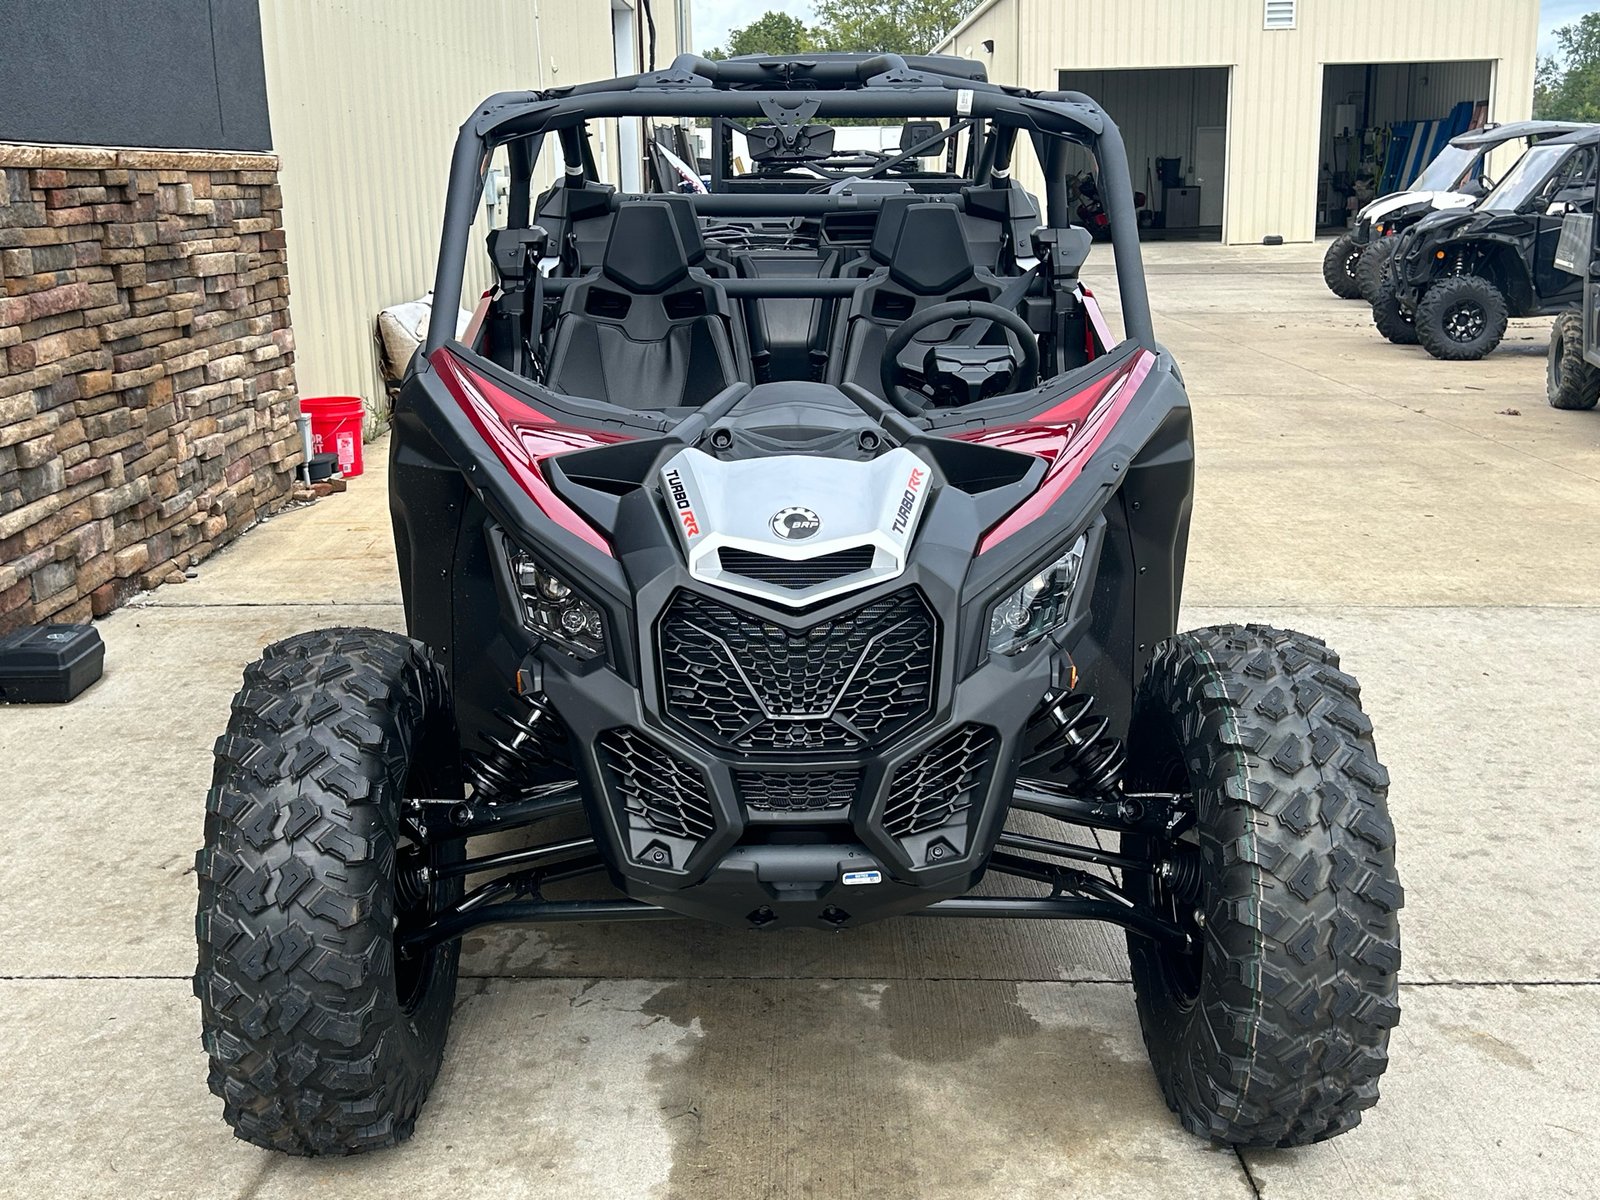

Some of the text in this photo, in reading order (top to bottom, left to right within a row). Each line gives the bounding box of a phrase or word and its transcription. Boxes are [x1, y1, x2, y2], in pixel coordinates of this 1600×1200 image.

[666, 469, 699, 538] TURBO RR
[791, 521, 819, 529] BRP
[892, 468, 924, 534] TURBO RR
